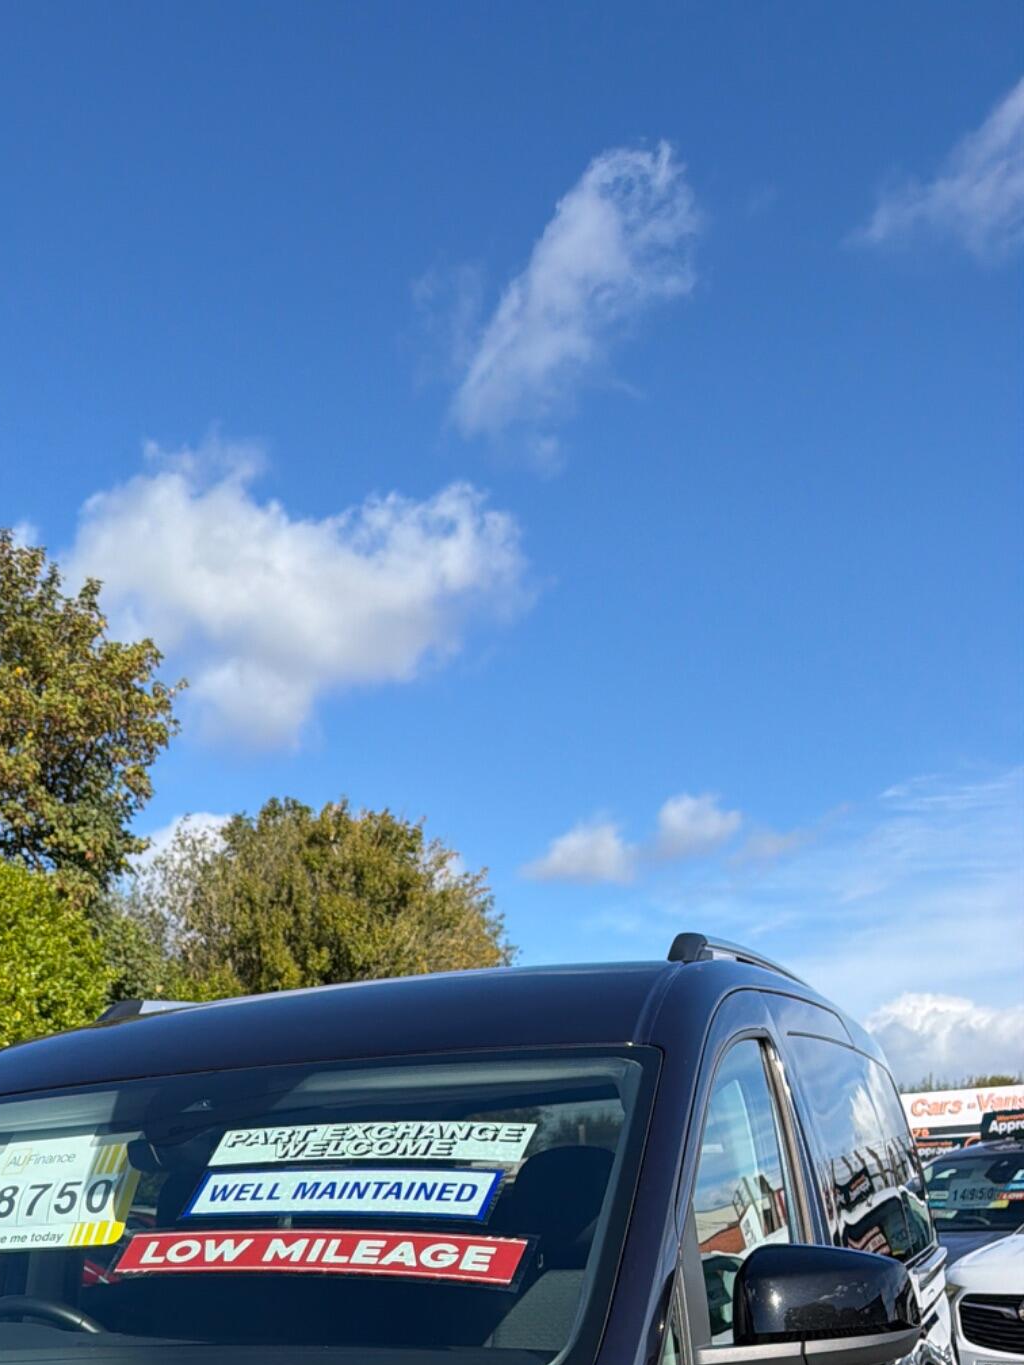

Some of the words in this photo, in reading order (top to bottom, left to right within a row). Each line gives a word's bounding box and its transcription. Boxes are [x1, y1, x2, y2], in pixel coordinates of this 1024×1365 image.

[911, 1098, 962, 1116] Cars
[226, 1126, 318, 1149] PART
[321, 1122, 525, 1143] EXCHANGE
[275, 1139, 457, 1158] WELCOME
[209, 1184, 281, 1203] WELL
[291, 1182, 478, 1203] MAINTAINED
[10, 1234, 28, 1244] me
[30, 1231, 64, 1244] today
[139, 1239, 253, 1264] LOW
[263, 1238, 496, 1272] MILEAGE
